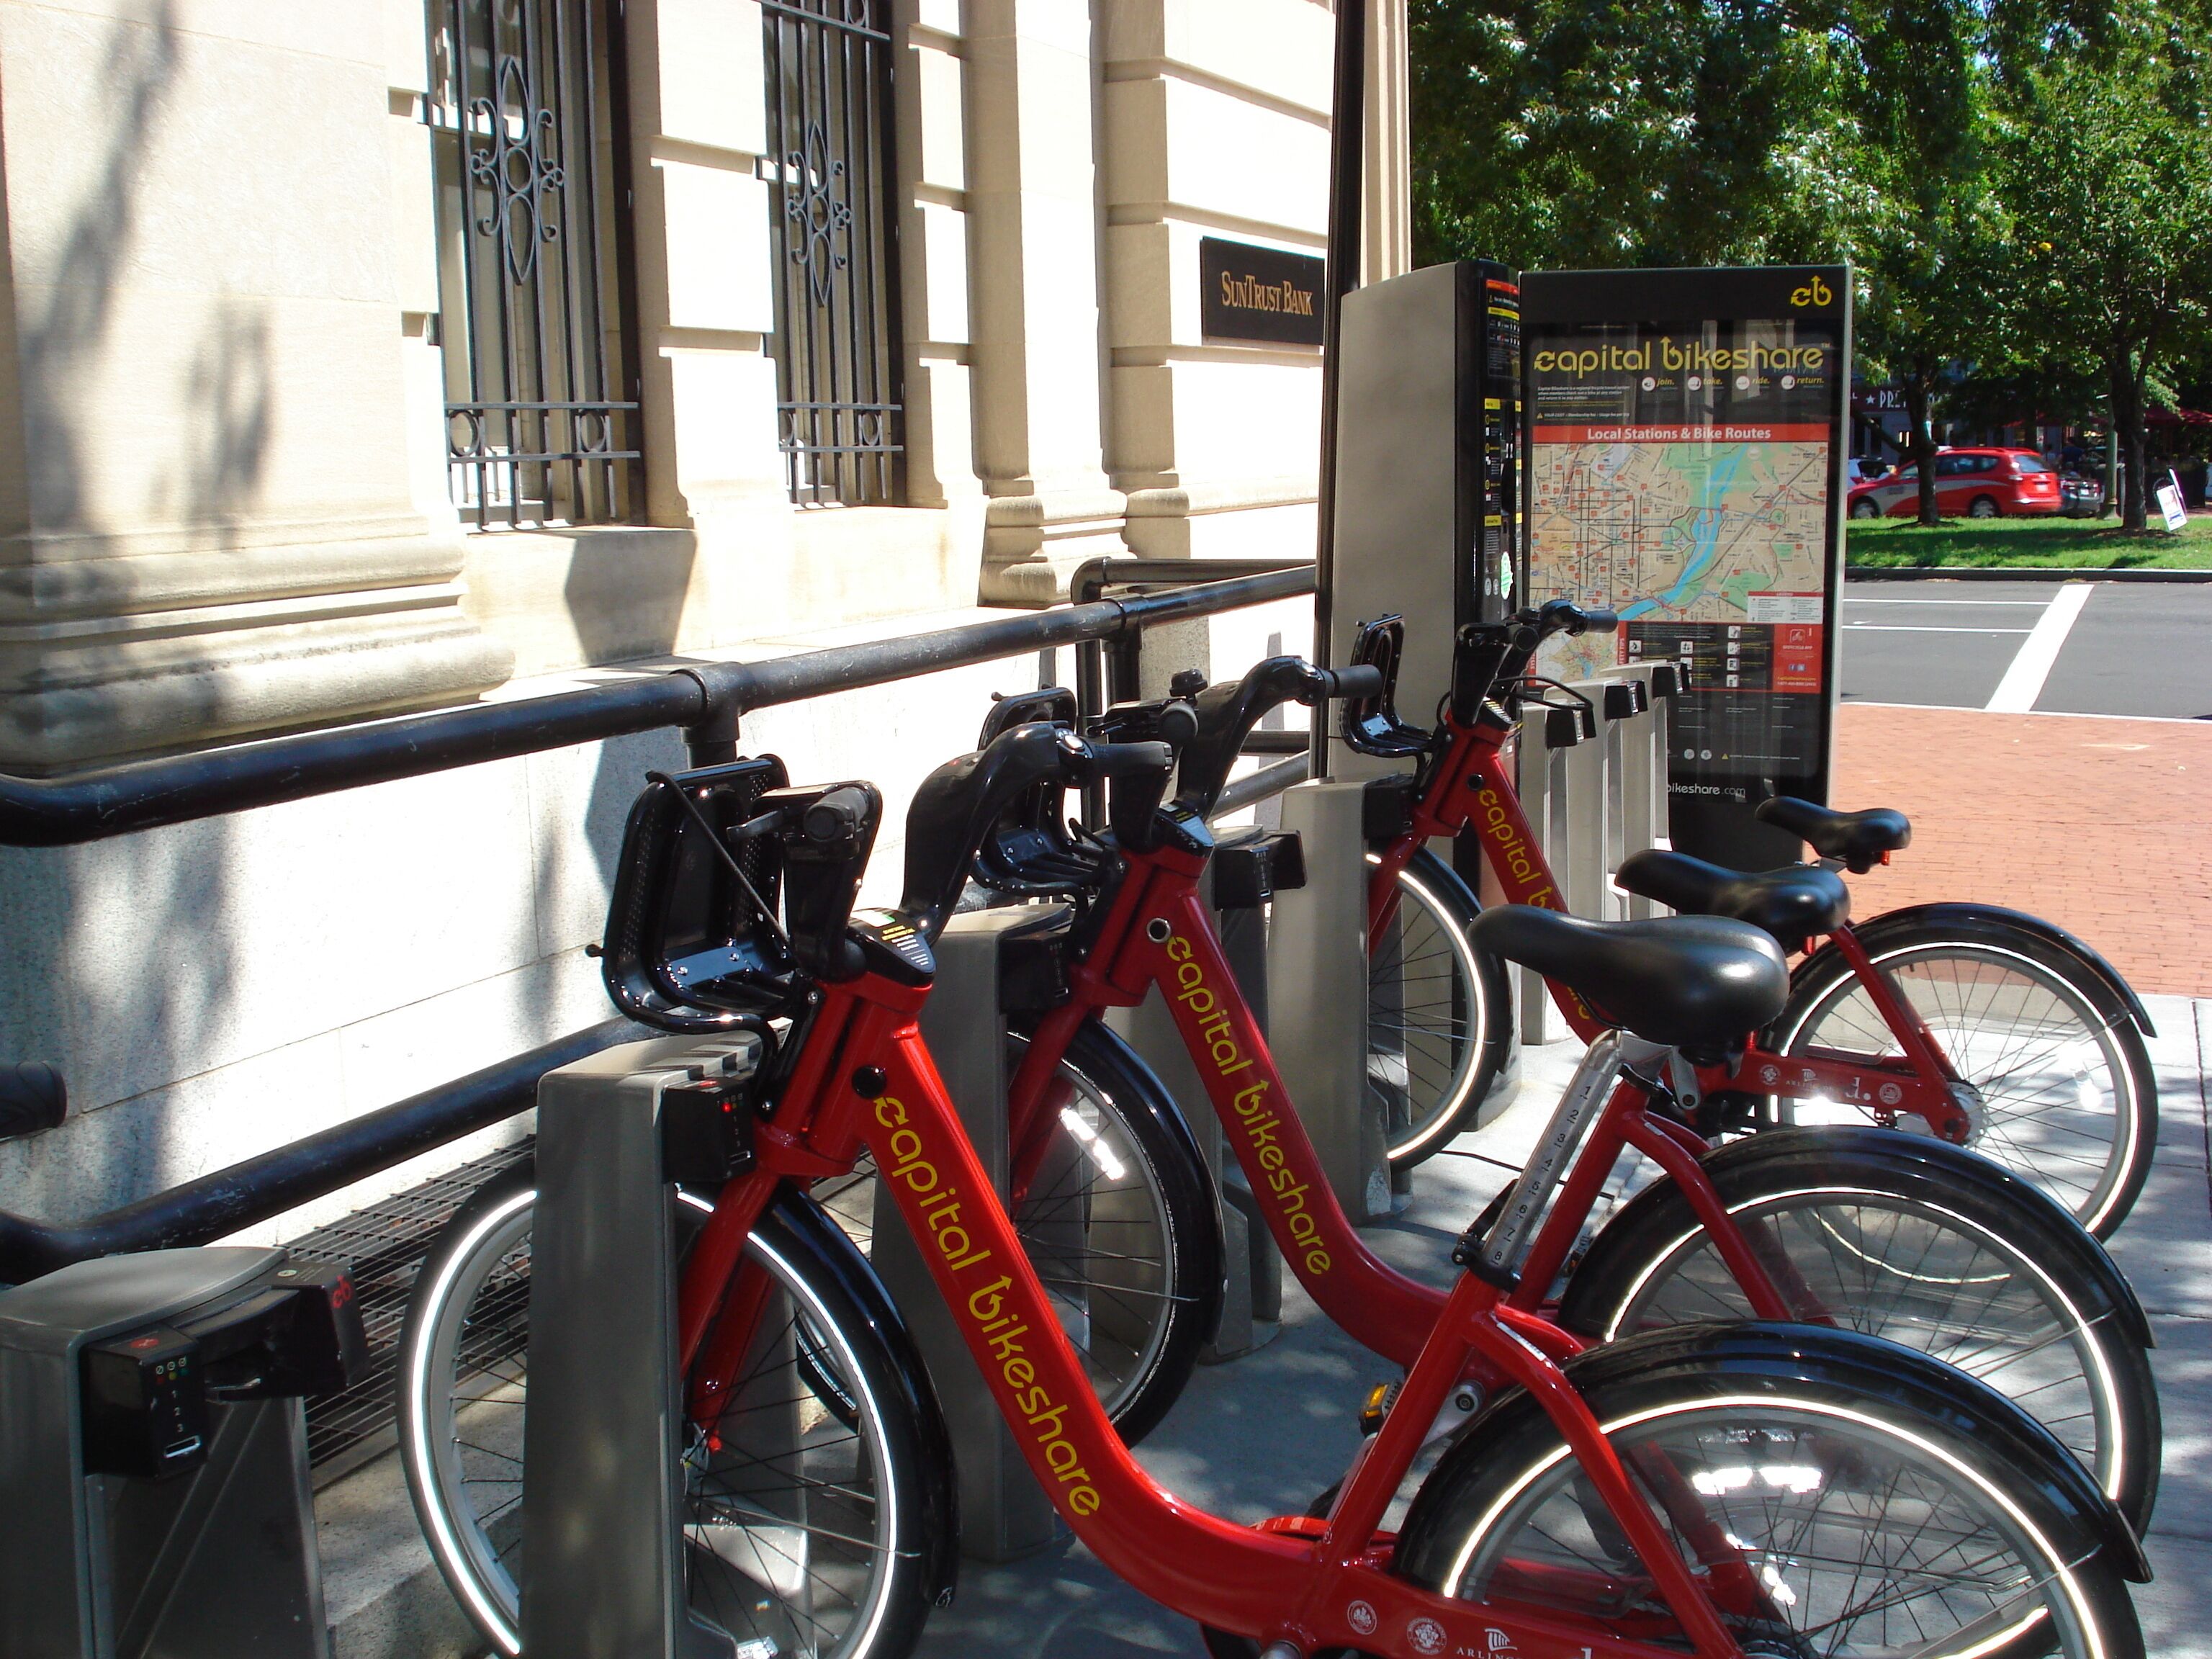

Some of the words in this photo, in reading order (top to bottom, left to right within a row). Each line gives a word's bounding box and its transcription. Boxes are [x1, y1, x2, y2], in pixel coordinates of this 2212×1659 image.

[1282, 280, 1313, 316] BANK
[1534, 341, 1651, 379] capital
[1660, 336, 1823, 369] bikeshare
[1588, 428, 1622, 439] Local
[1624, 428, 1678, 439] Stations
[1681, 428, 1691, 439] &
[1694, 427, 1722, 439] Bike
[1725, 427, 1771, 439] Routes
[1479, 789, 1542, 884] capital
[1166, 936, 1253, 1076] capital
[1234, 1079, 1331, 1275] bikeshare
[873, 1097, 991, 1271] capital
[968, 1274, 1100, 1516] bikeshare
[1457, 1647, 1515, 1659] ARLIN
